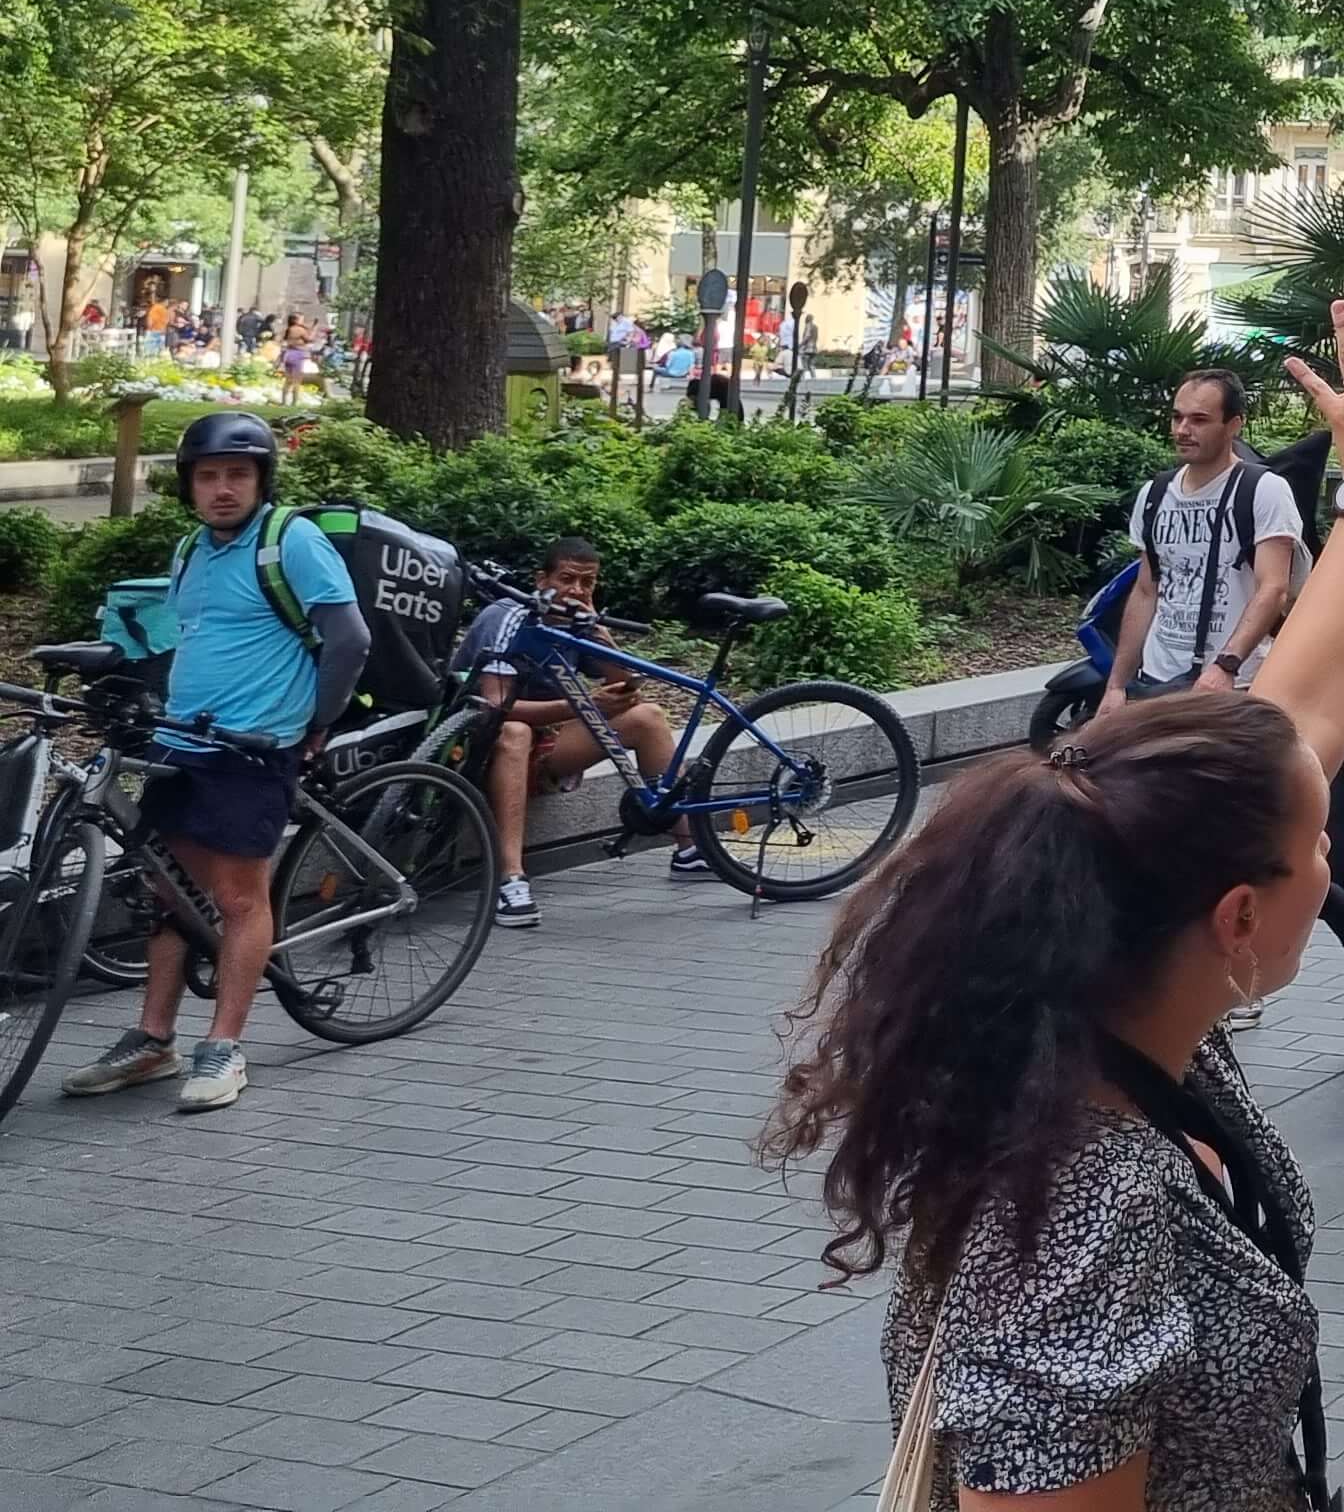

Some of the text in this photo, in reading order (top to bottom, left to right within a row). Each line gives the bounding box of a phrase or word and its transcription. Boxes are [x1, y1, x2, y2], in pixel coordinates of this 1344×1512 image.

[1153, 506, 1235, 545] GENESS
[381, 544, 449, 588] Uber
[375, 579, 443, 623] Eats
